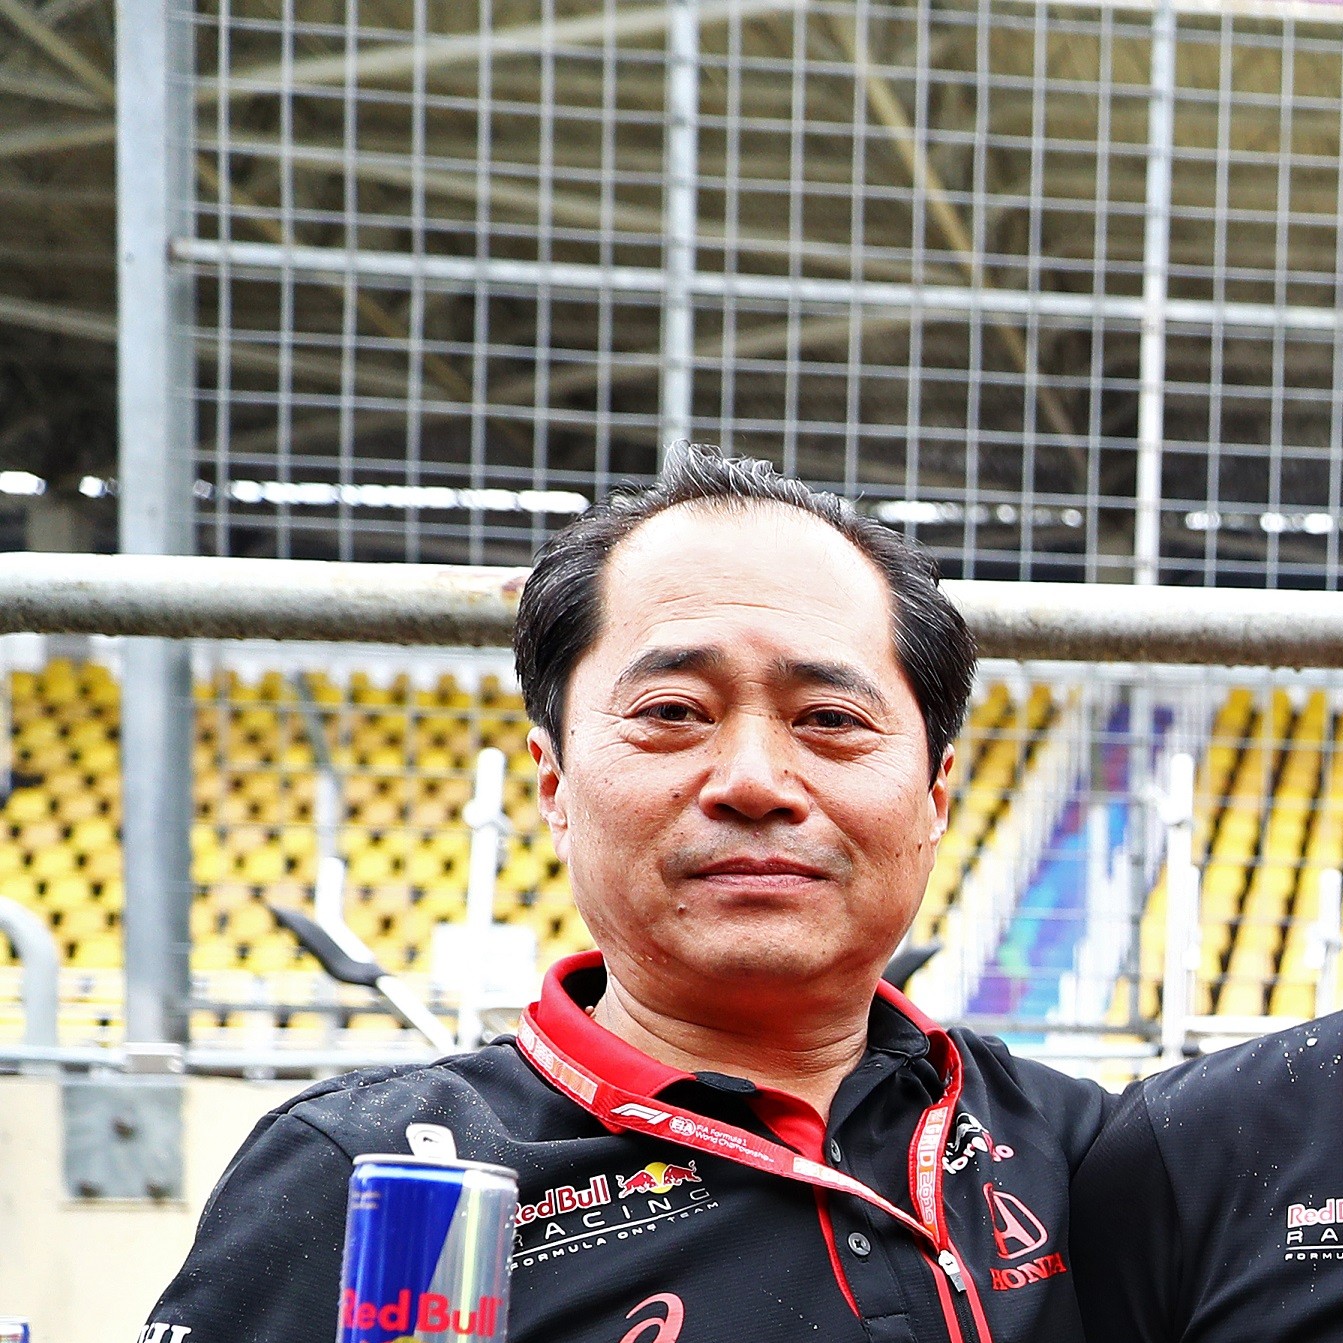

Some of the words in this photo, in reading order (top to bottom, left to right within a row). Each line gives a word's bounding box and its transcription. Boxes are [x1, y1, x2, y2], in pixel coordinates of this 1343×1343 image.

[556, 1175, 611, 1213] Bull
[1289, 1200, 1333, 1227] Red
[418, 1291, 499, 1338] Bull
